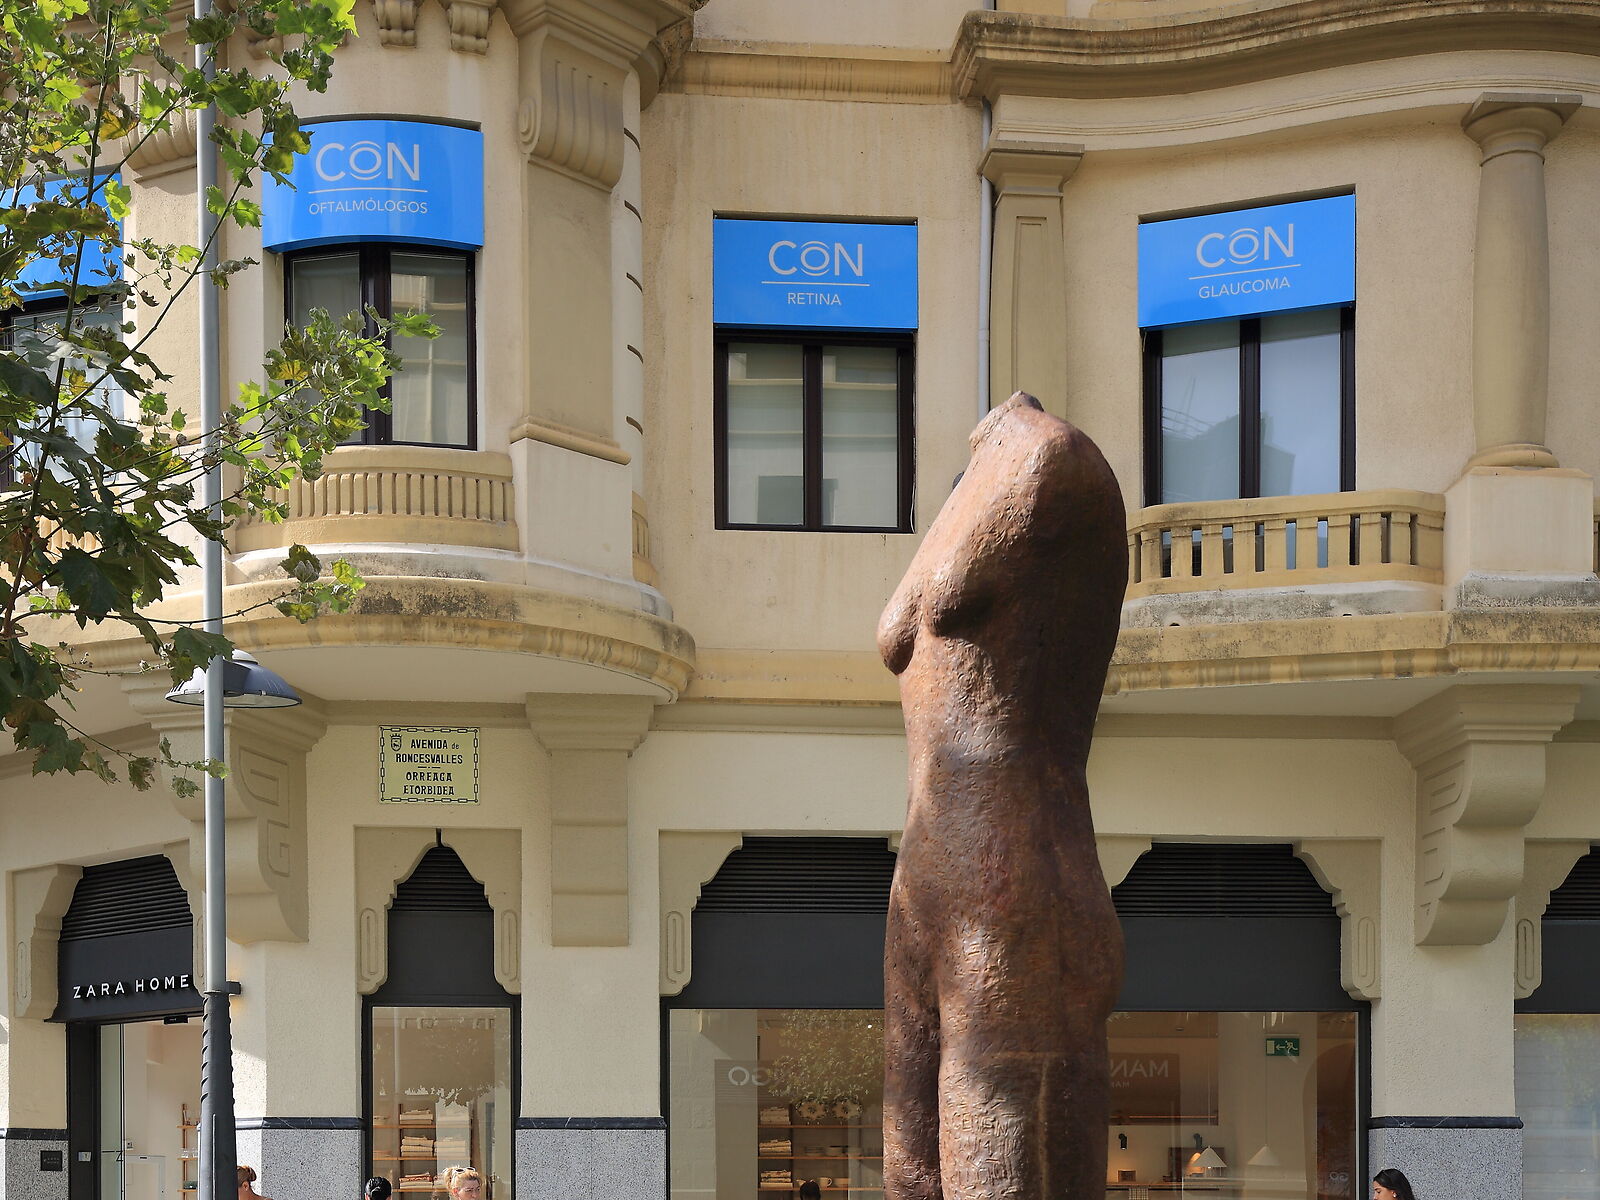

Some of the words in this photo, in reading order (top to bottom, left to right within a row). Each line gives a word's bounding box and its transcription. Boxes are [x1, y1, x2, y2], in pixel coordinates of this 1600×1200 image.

[315, 140, 420, 182] CON
[308, 197, 428, 215] OFTALMÓLOGOS
[1196, 223, 1294, 268] CON
[768, 240, 864, 277] CON
[1198, 276, 1291, 299] GLAUCOMA
[787, 292, 842, 305] RETINA
[410, 739, 448, 749] AVENIDA
[451, 742, 459, 750] de
[396, 753, 463, 764] RONCESVALLES
[405, 771, 453, 782] ORREAGA
[403, 784, 455, 796] ETORBIDEA
[73, 981, 125, 999] ZARA
[135, 974, 189, 993] HOME
